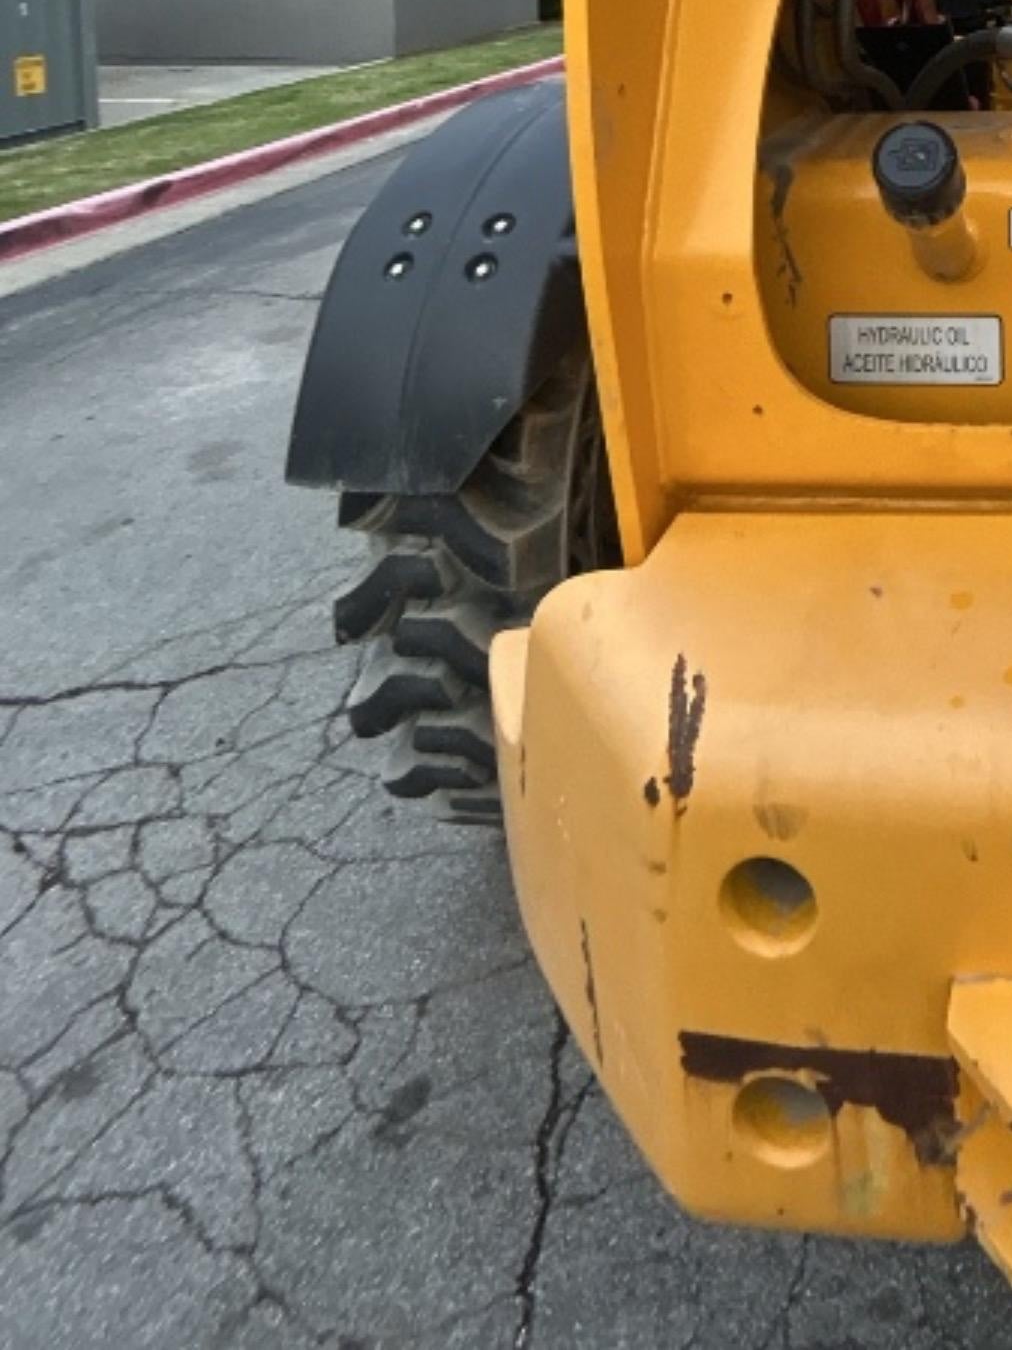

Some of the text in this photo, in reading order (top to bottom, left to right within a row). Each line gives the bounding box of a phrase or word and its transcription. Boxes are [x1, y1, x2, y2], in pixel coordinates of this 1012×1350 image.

[857, 325, 970, 346] HYDRAULIC OIL
[842, 353, 895, 373] ACEITE
